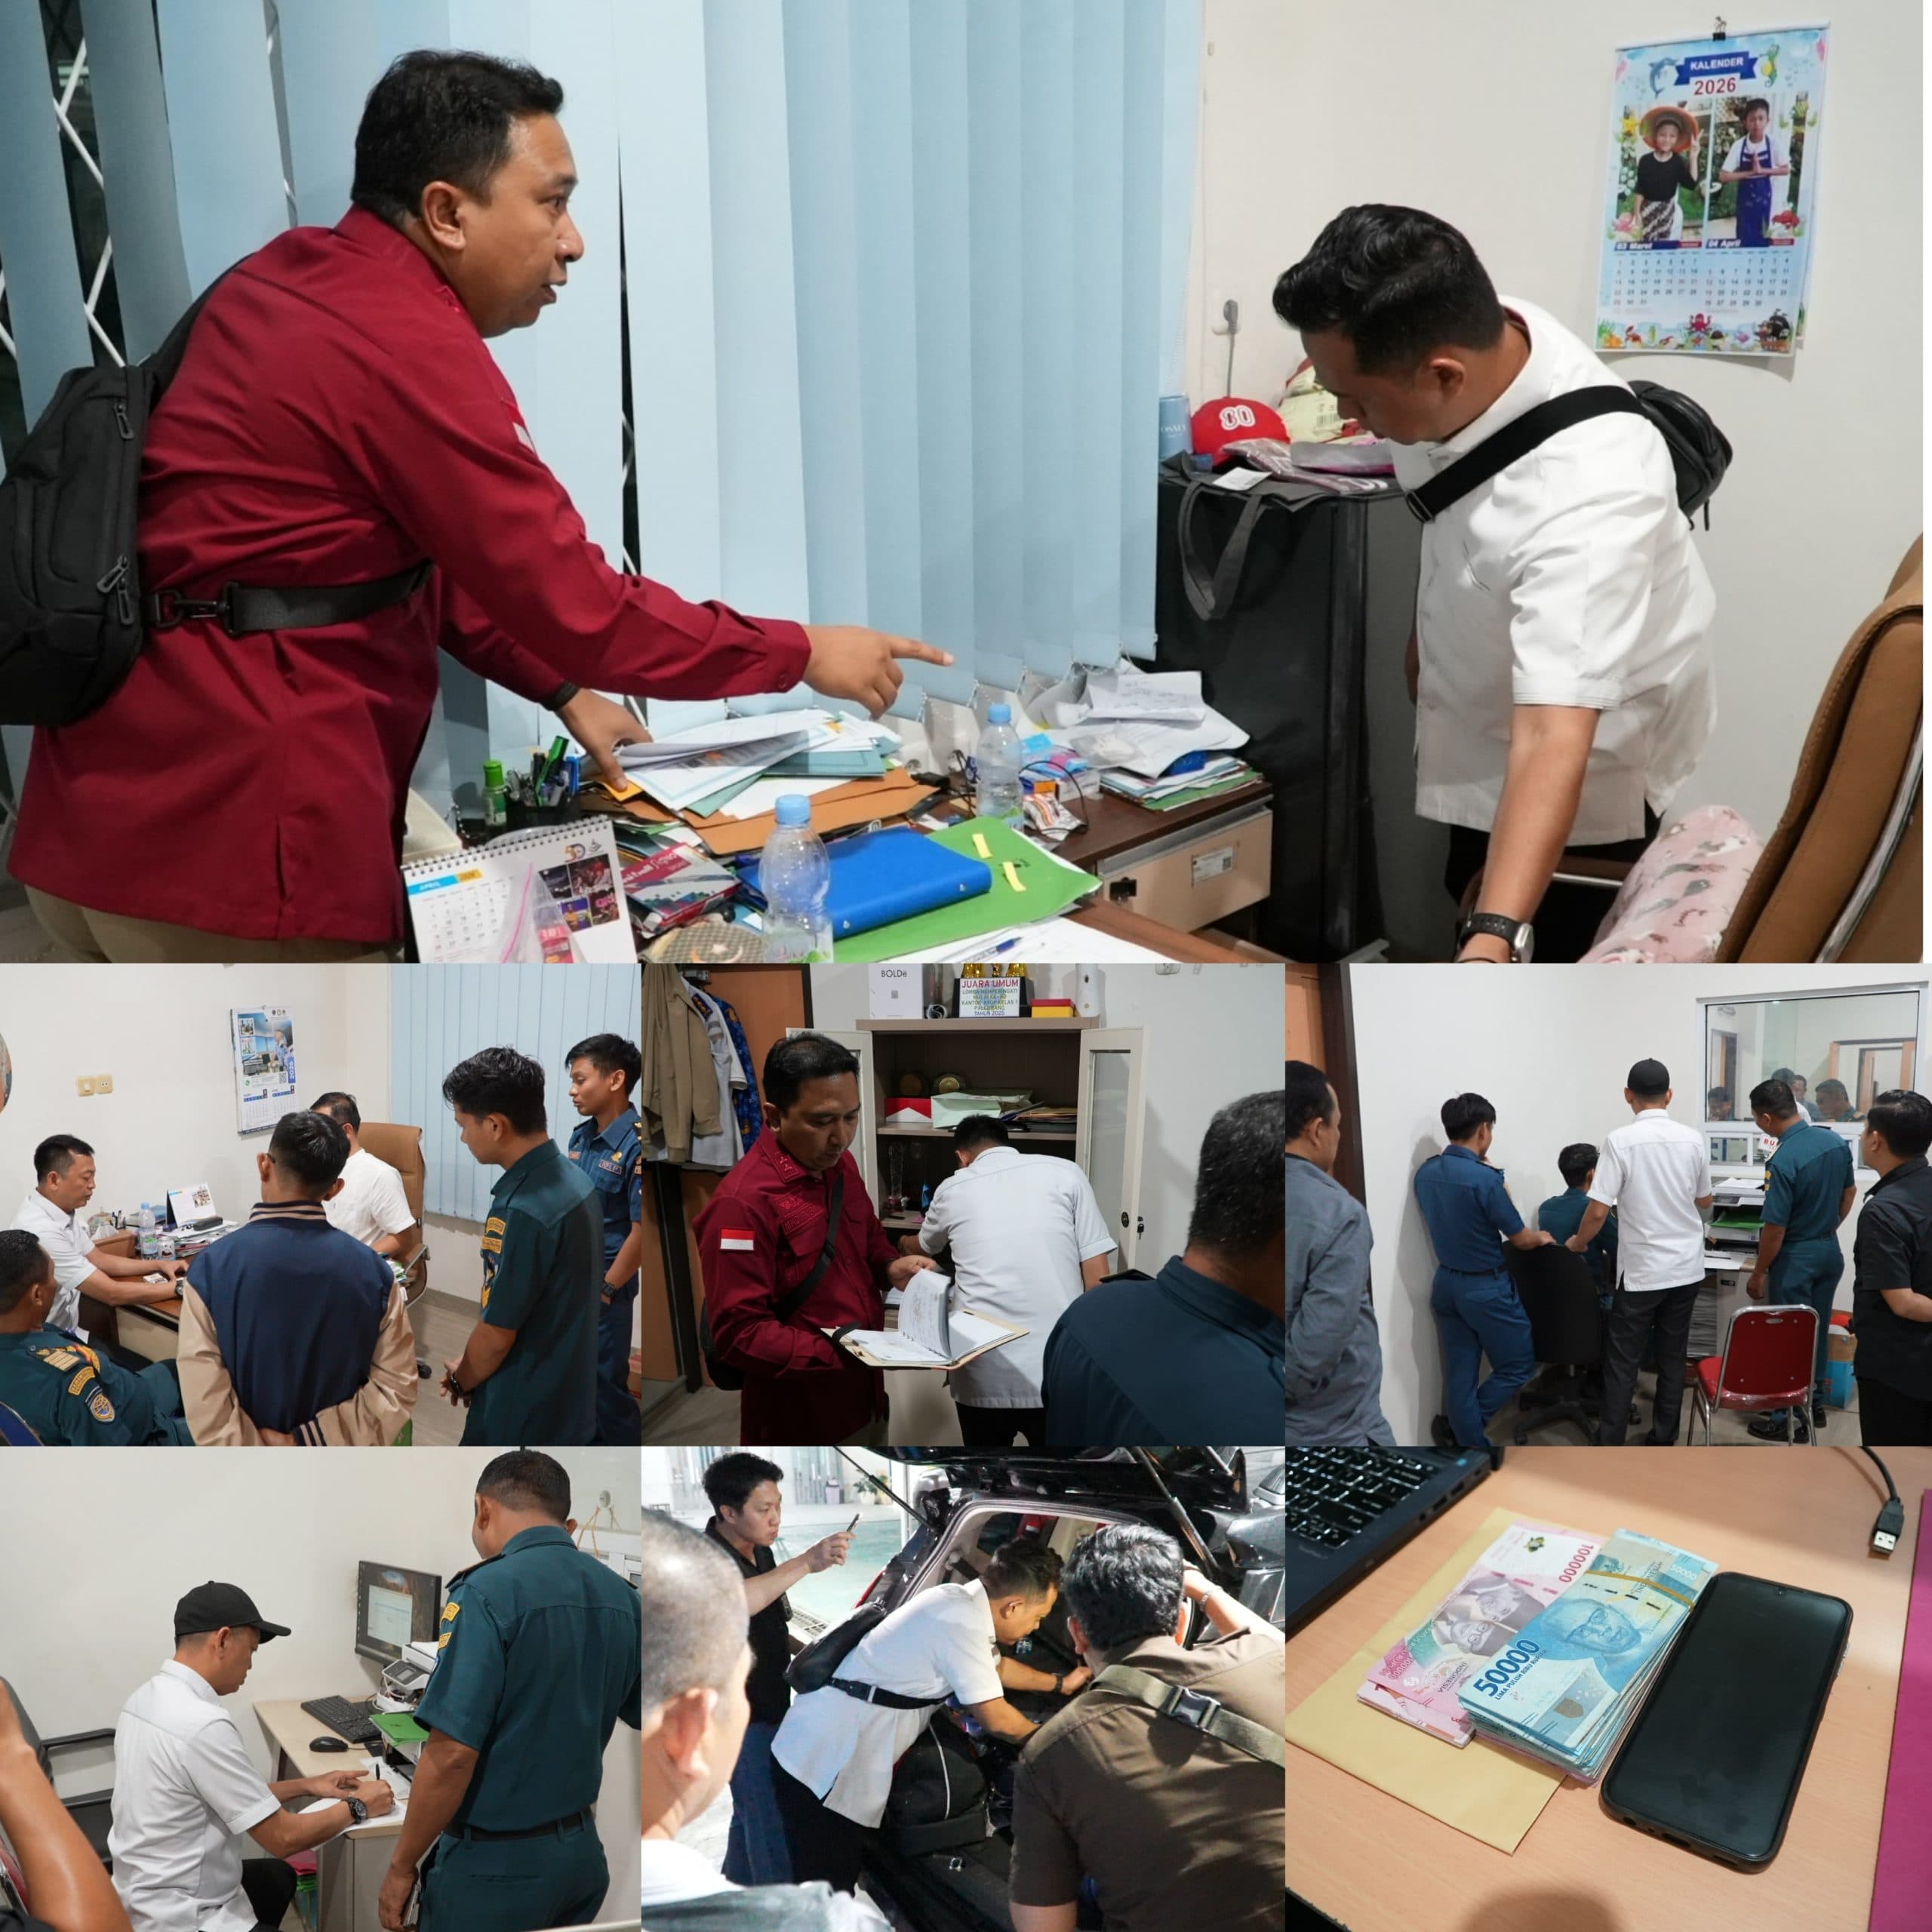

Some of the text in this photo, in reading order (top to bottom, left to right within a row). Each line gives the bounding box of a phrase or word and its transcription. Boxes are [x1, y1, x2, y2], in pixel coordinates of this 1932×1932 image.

[1690, 57, 1744, 71] KALENDER
[1694, 77, 1737, 96] 2026
[1558, 1545, 1595, 1583] 100000
[1670, 1564, 1697, 1581] 50000
[1389, 1656, 1414, 1679] 100000
[1437, 1661, 1467, 1693] INDONESIA
[1473, 1639, 1540, 1697] 50000
[1495, 1686, 1509, 1700] LIMA
[1506, 1673, 1523, 1688] PULUH
[1521, 1663, 1533, 1675] RIBU
